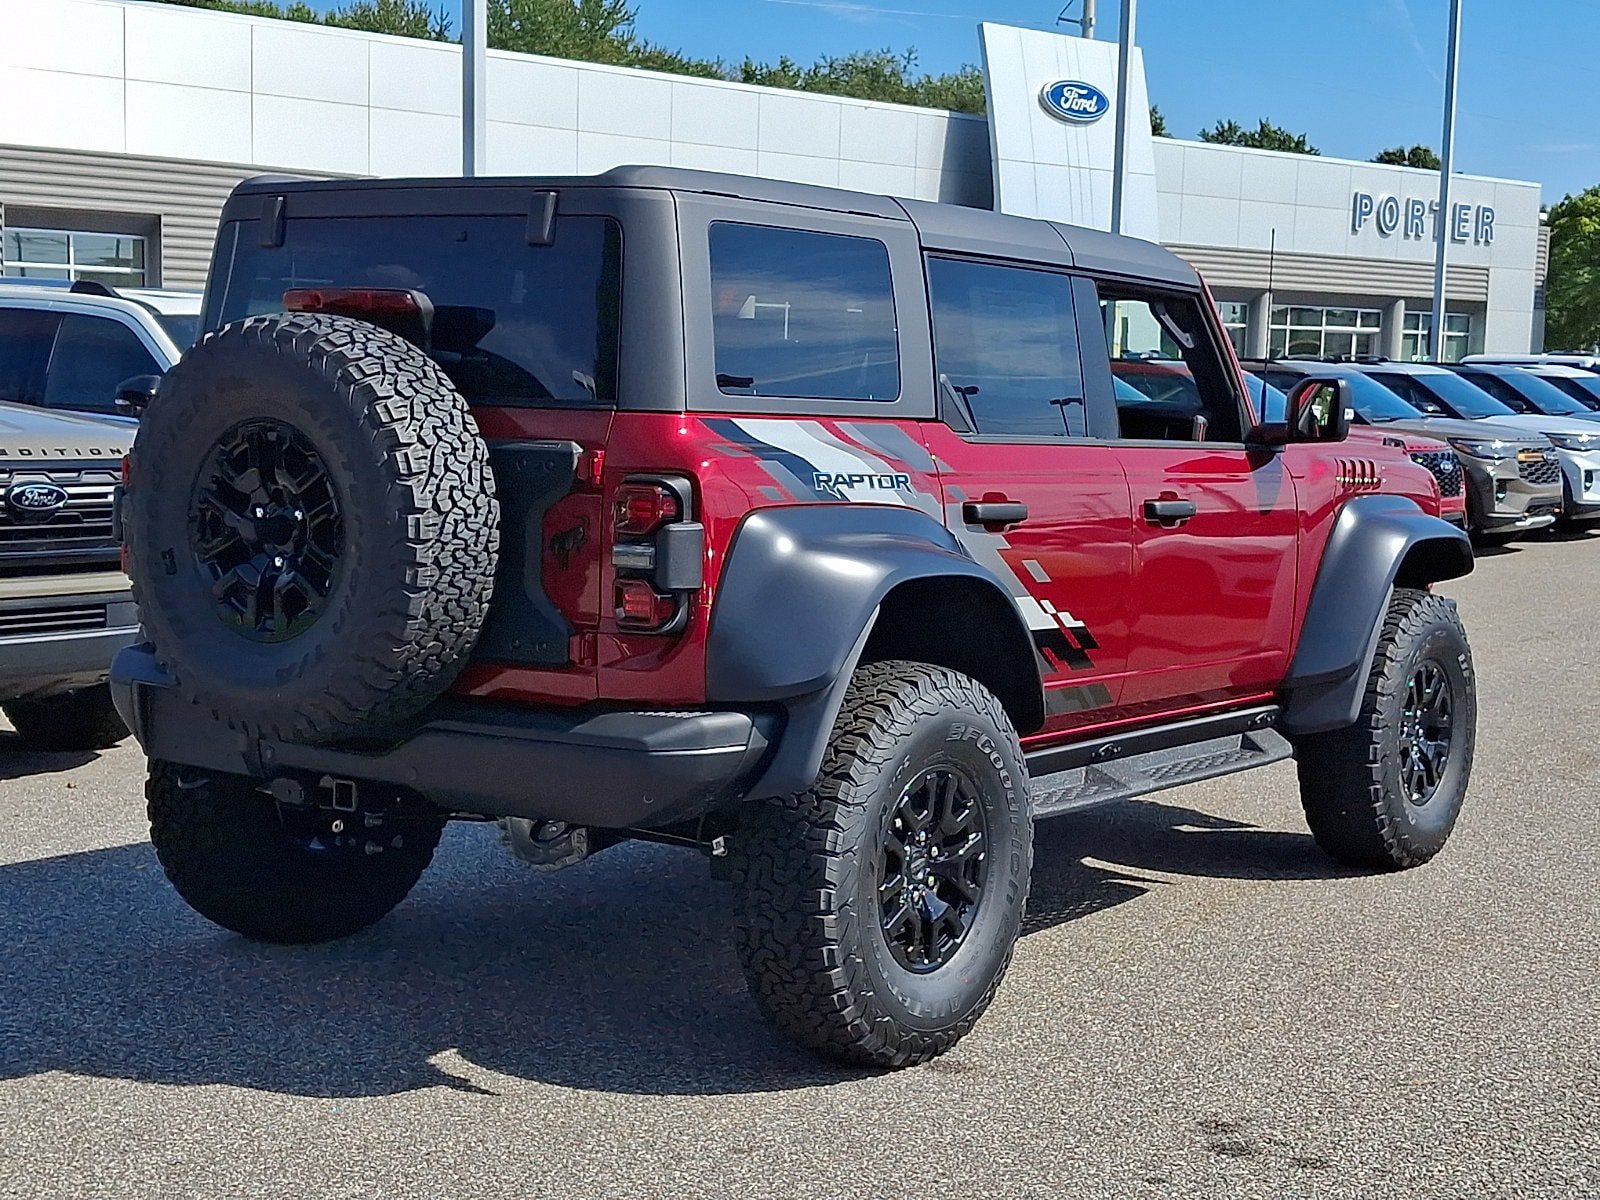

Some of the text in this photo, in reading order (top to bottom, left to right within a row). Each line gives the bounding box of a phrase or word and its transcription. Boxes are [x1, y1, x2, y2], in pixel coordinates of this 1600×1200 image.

[1060, 86, 1098, 113] Ford
[21, 488, 58, 506] Ford
[813, 472, 917, 499] RAPTOR
